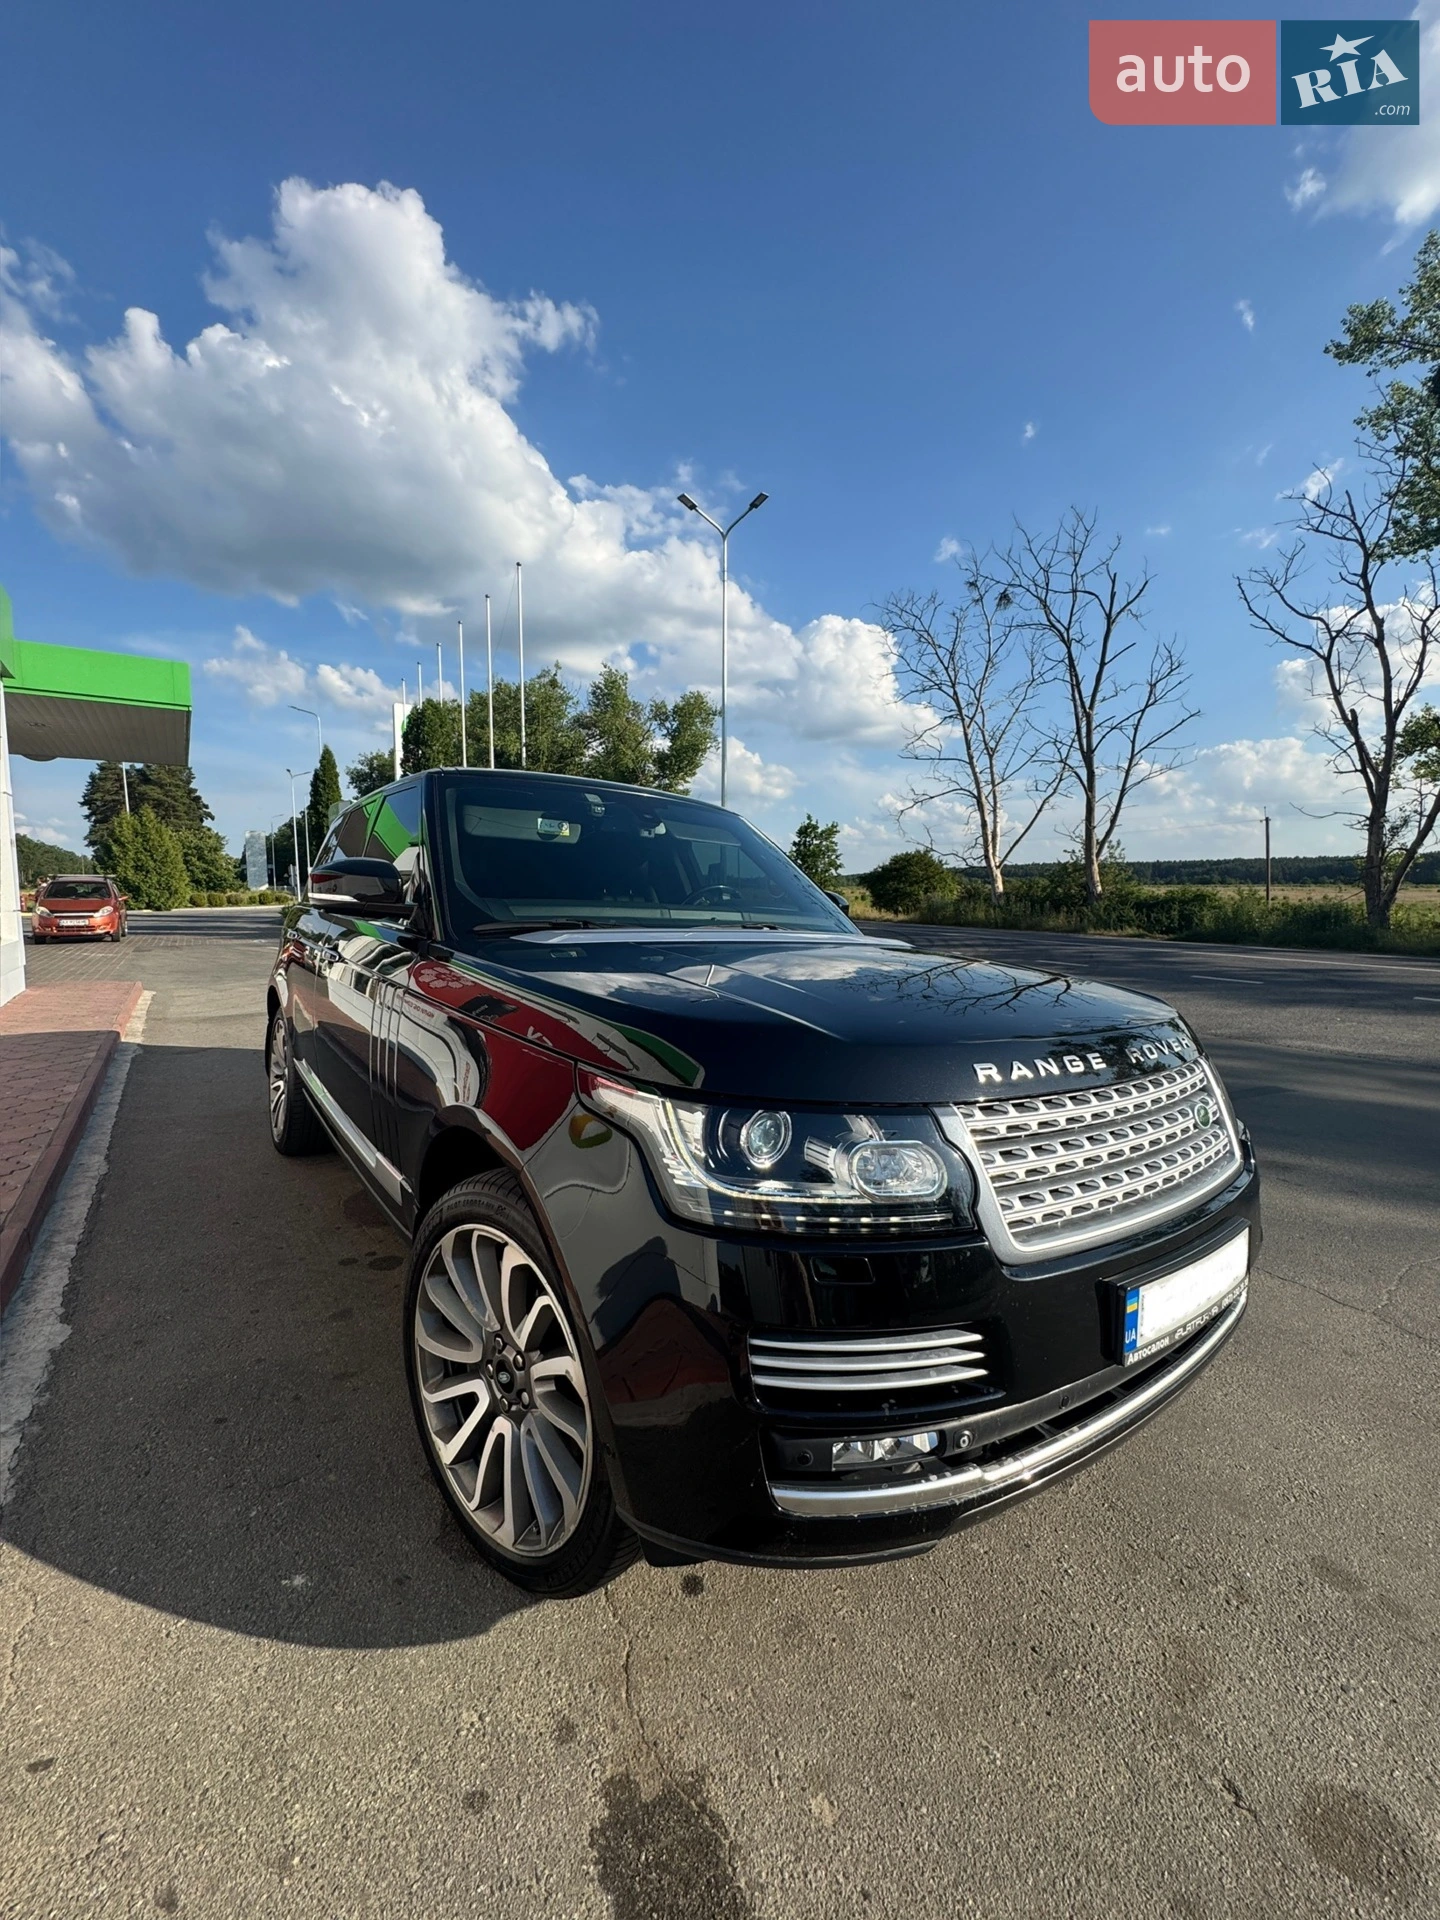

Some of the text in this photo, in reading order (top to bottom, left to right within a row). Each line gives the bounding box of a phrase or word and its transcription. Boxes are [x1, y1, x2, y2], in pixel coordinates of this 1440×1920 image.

[972, 1035, 1191, 1084] RANGE ROVER
[1125, 1327, 1137, 1344] UA
